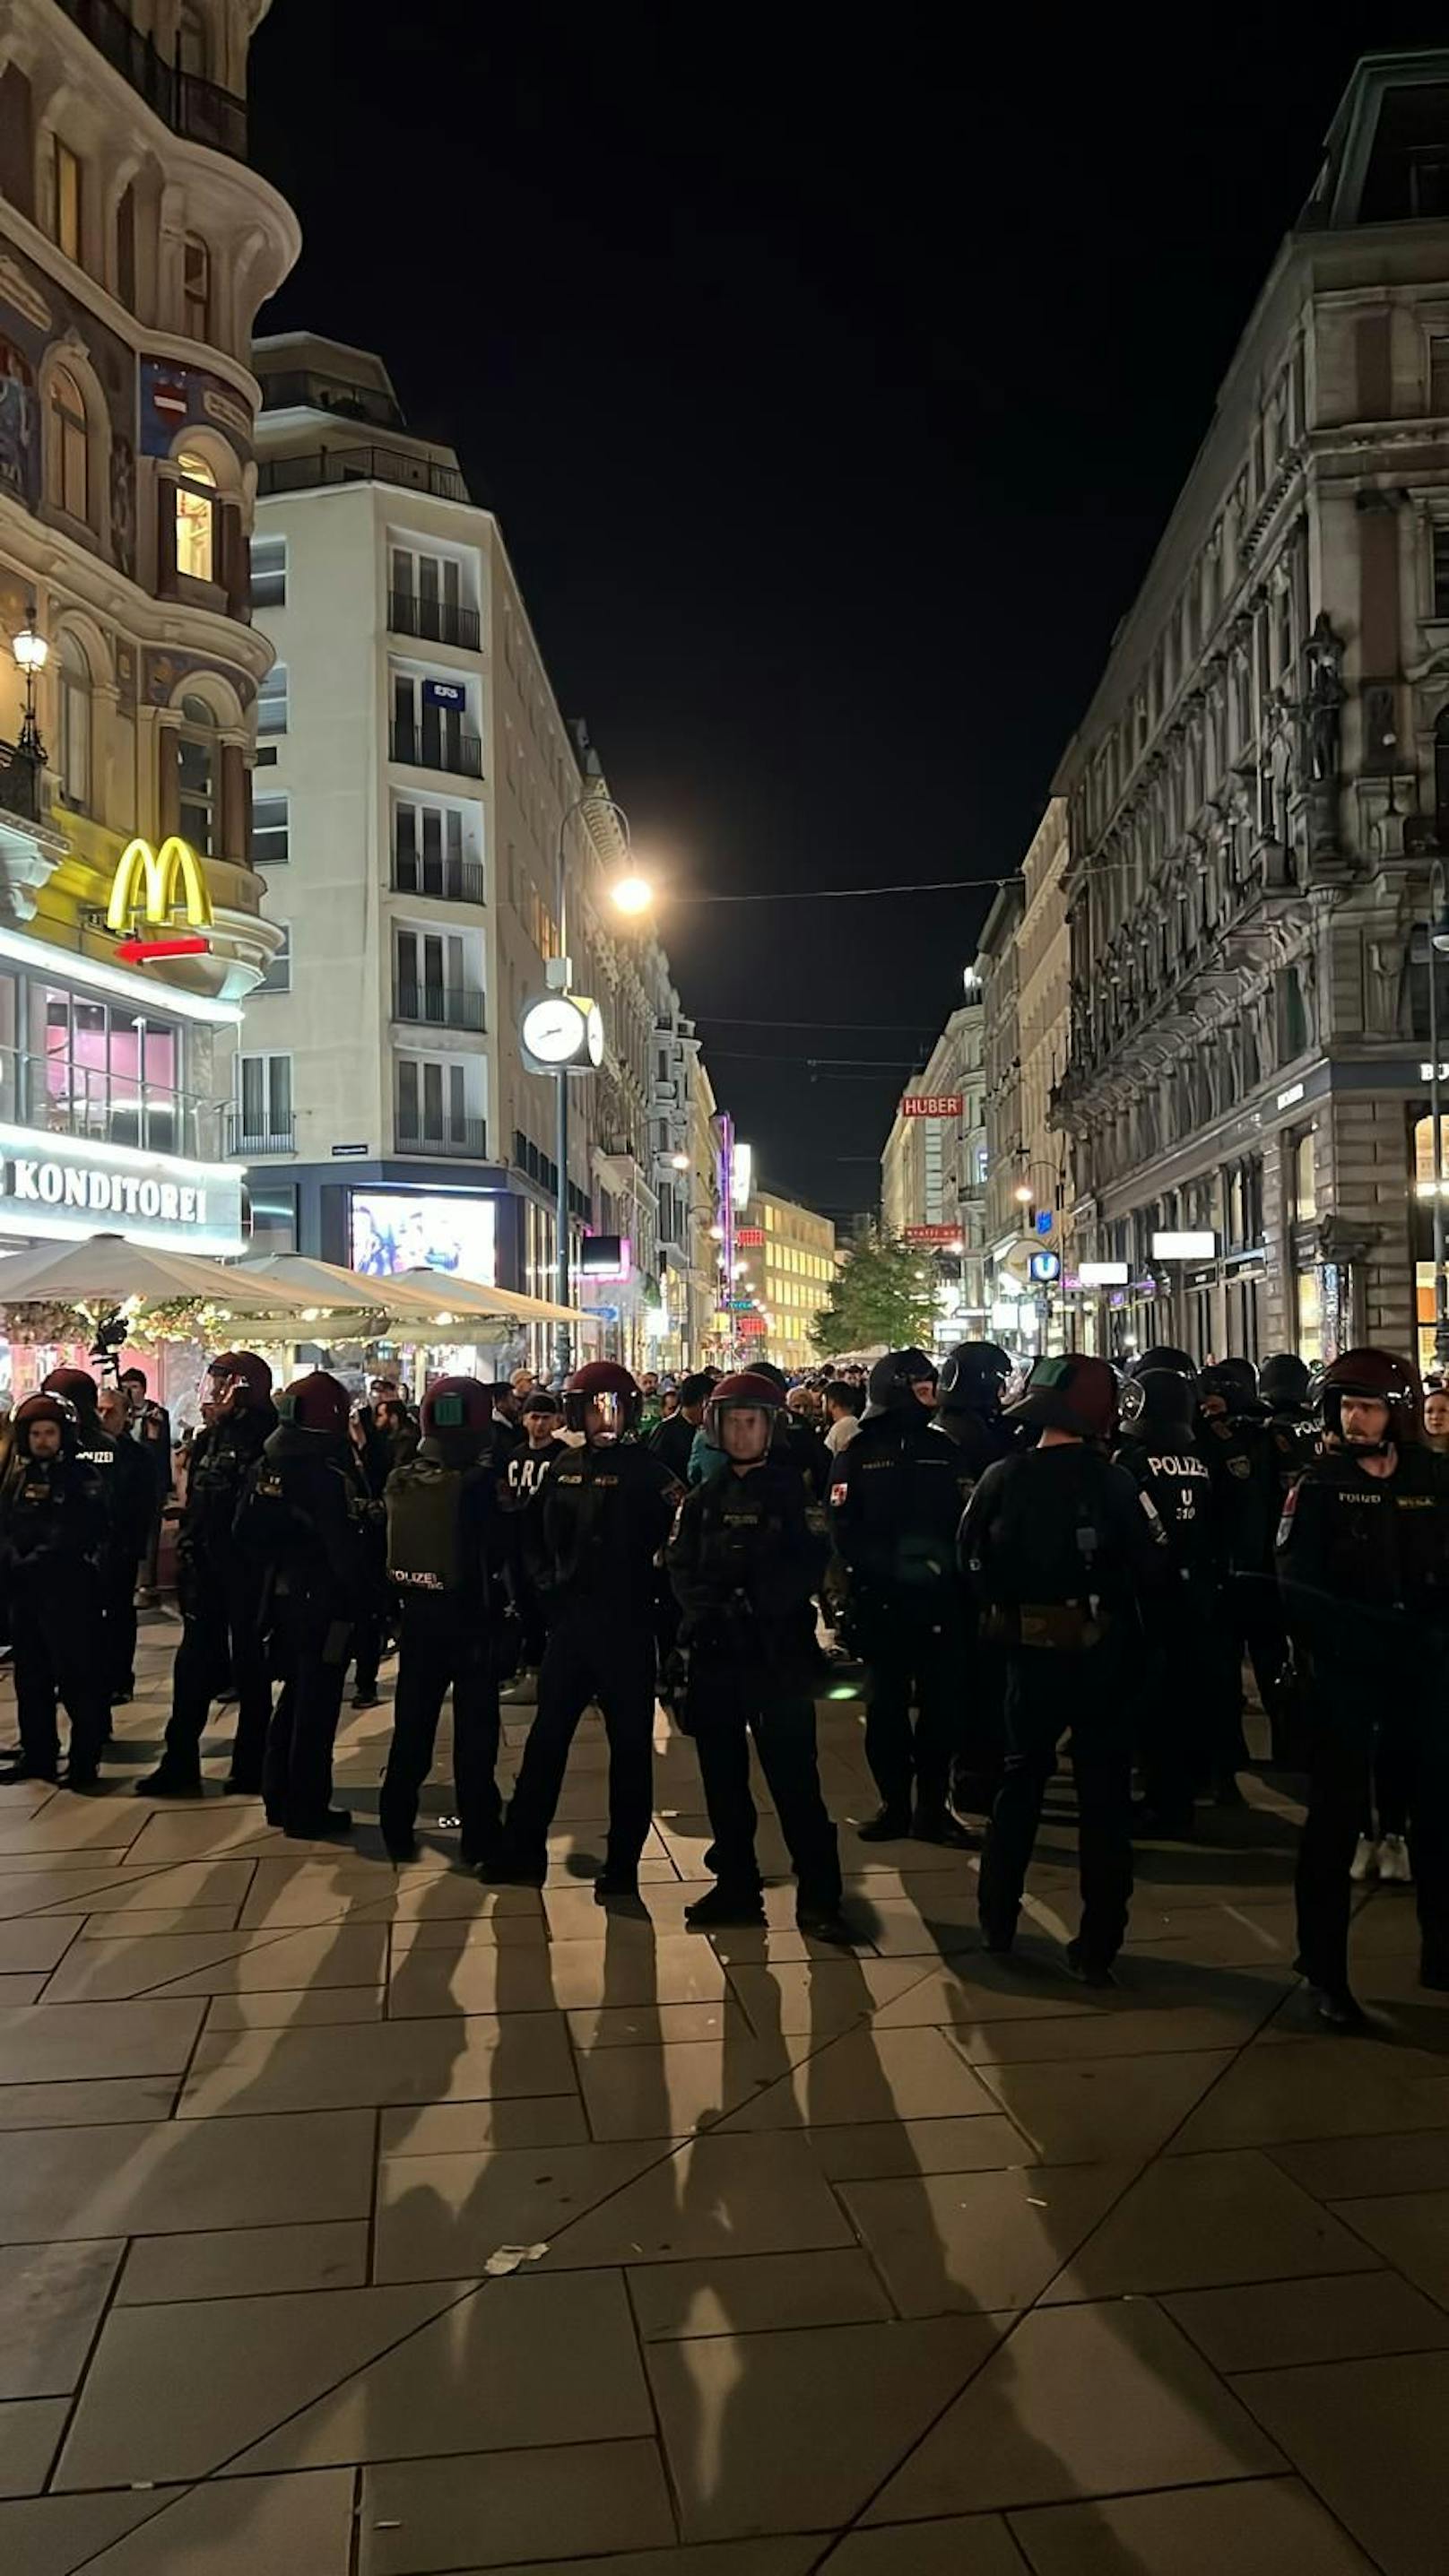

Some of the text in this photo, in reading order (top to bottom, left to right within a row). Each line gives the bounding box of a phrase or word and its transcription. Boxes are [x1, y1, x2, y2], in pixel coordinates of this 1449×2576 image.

[905, 1097, 957, 1115] HUBER
[14, 1159, 207, 1224] KONDITOREI
[1035, 1254, 1057, 1279] U
[1315, 1441, 1323, 1455] U
[1182, 1488, 1193, 1506] U
